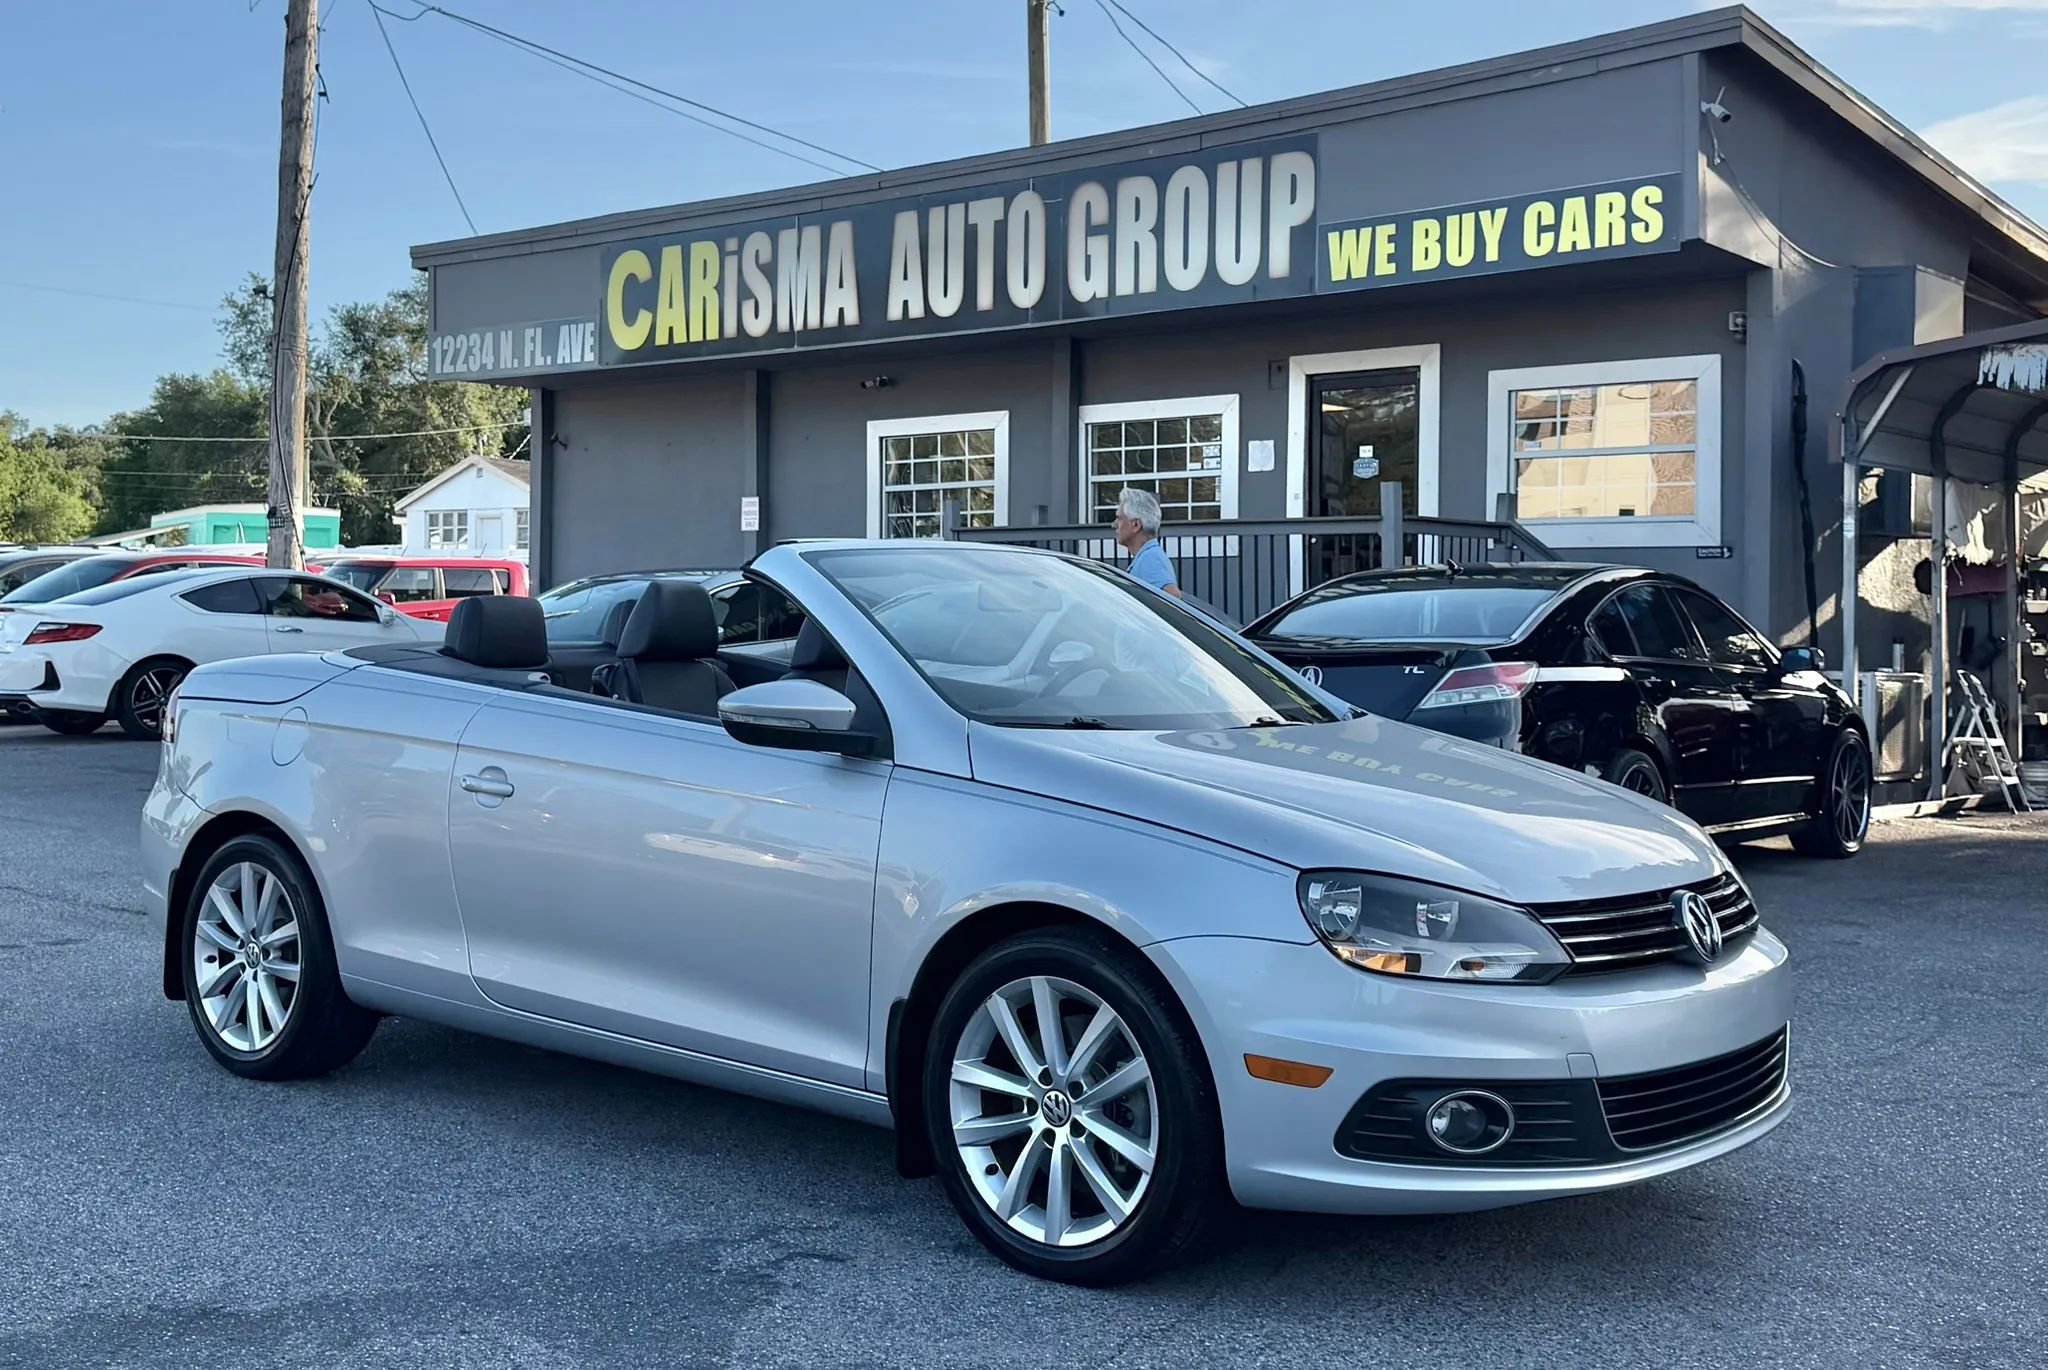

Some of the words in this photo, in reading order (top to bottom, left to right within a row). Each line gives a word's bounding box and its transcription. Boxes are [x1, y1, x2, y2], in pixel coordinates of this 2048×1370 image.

[887, 190, 1046, 321] AUTO
[1067, 151, 1316, 303] GROUP
[1327, 223, 1396, 281] WE
[1412, 207, 1508, 271] BUY
[1523, 185, 1664, 257] CARS
[432, 332, 494, 374] 12234
[500, 330, 519, 369] N.
[524, 327, 552, 367] FL.
[557, 322, 595, 364] AVE
[1403, 666, 1424, 674] TL
